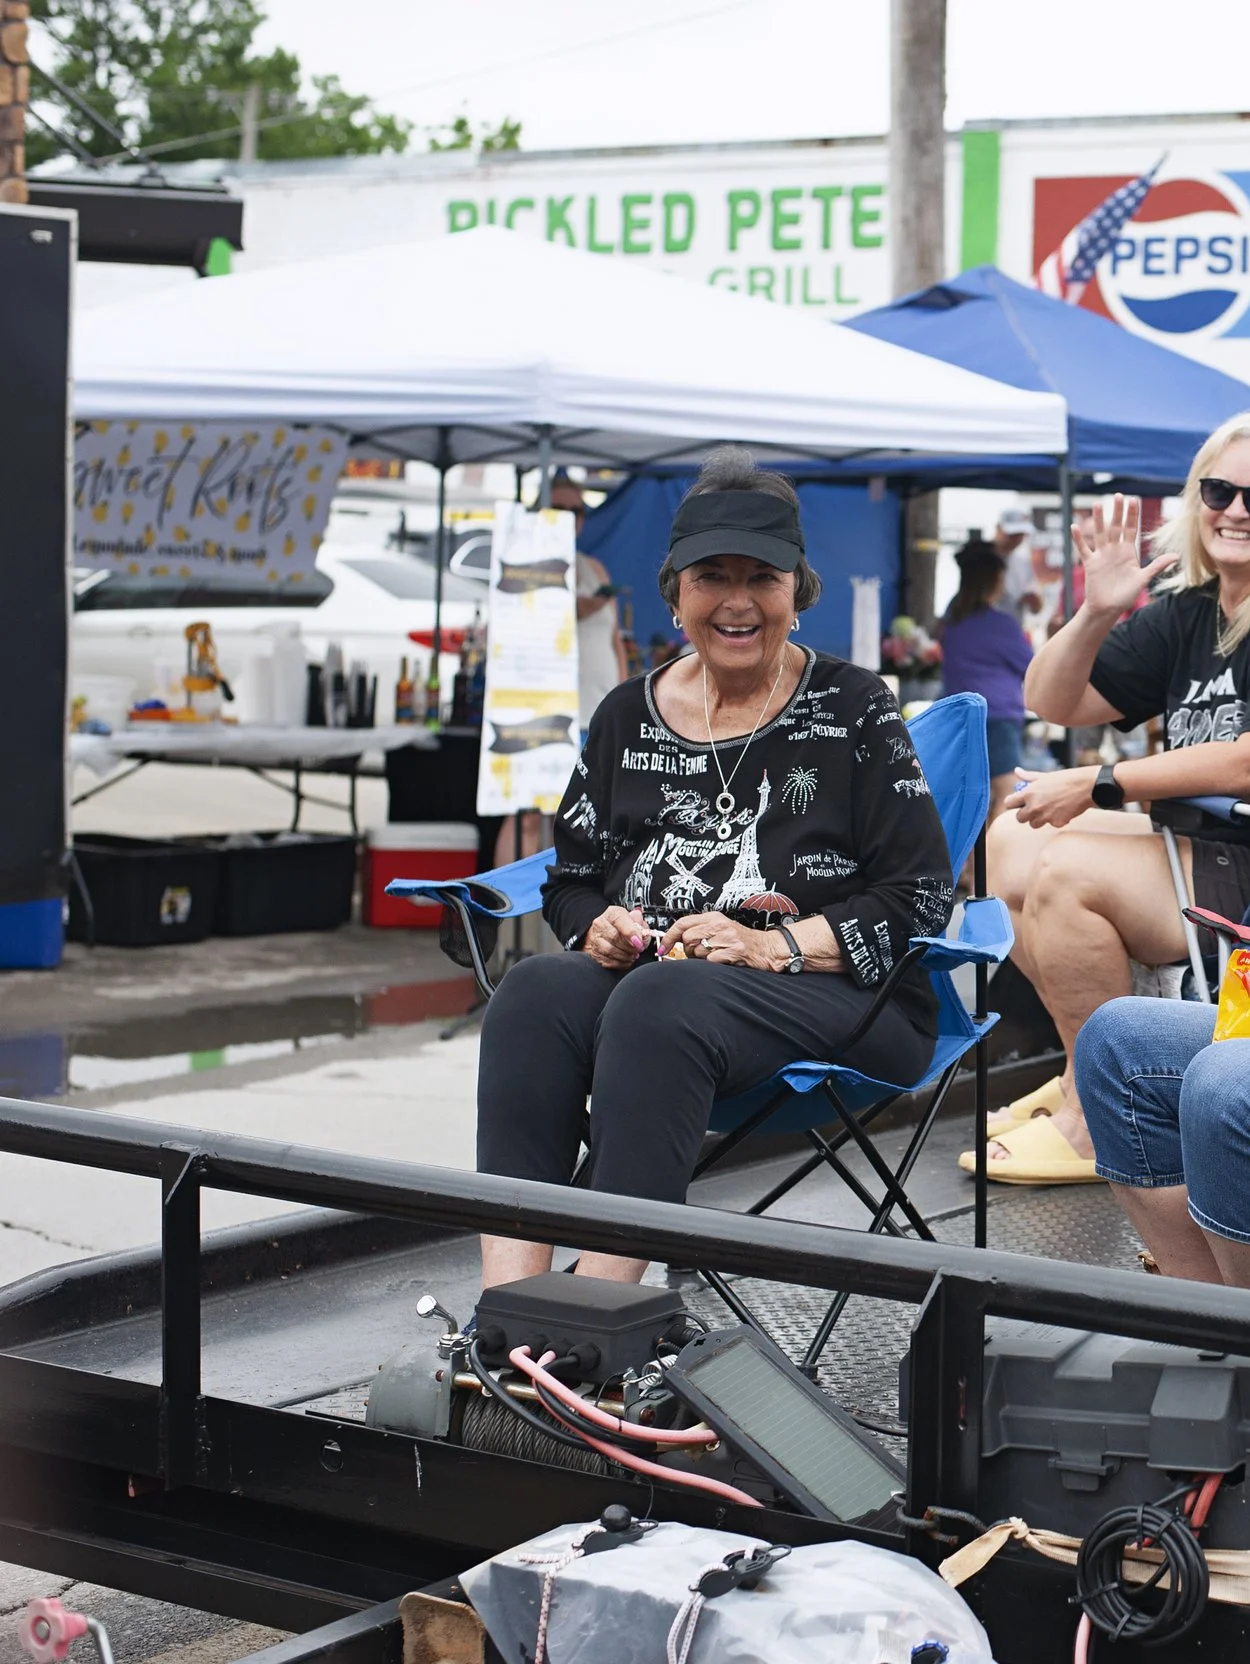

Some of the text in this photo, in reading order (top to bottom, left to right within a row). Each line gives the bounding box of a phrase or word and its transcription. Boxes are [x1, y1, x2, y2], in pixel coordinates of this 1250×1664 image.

[727, 185, 883, 251] PETE
[1110, 235, 1250, 276] PEPSI
[621, 747, 649, 771] ARTS
[650, 752, 665, 772] DE
[665, 756, 678, 775] LA
[789, 853, 822, 877] JARDIN
